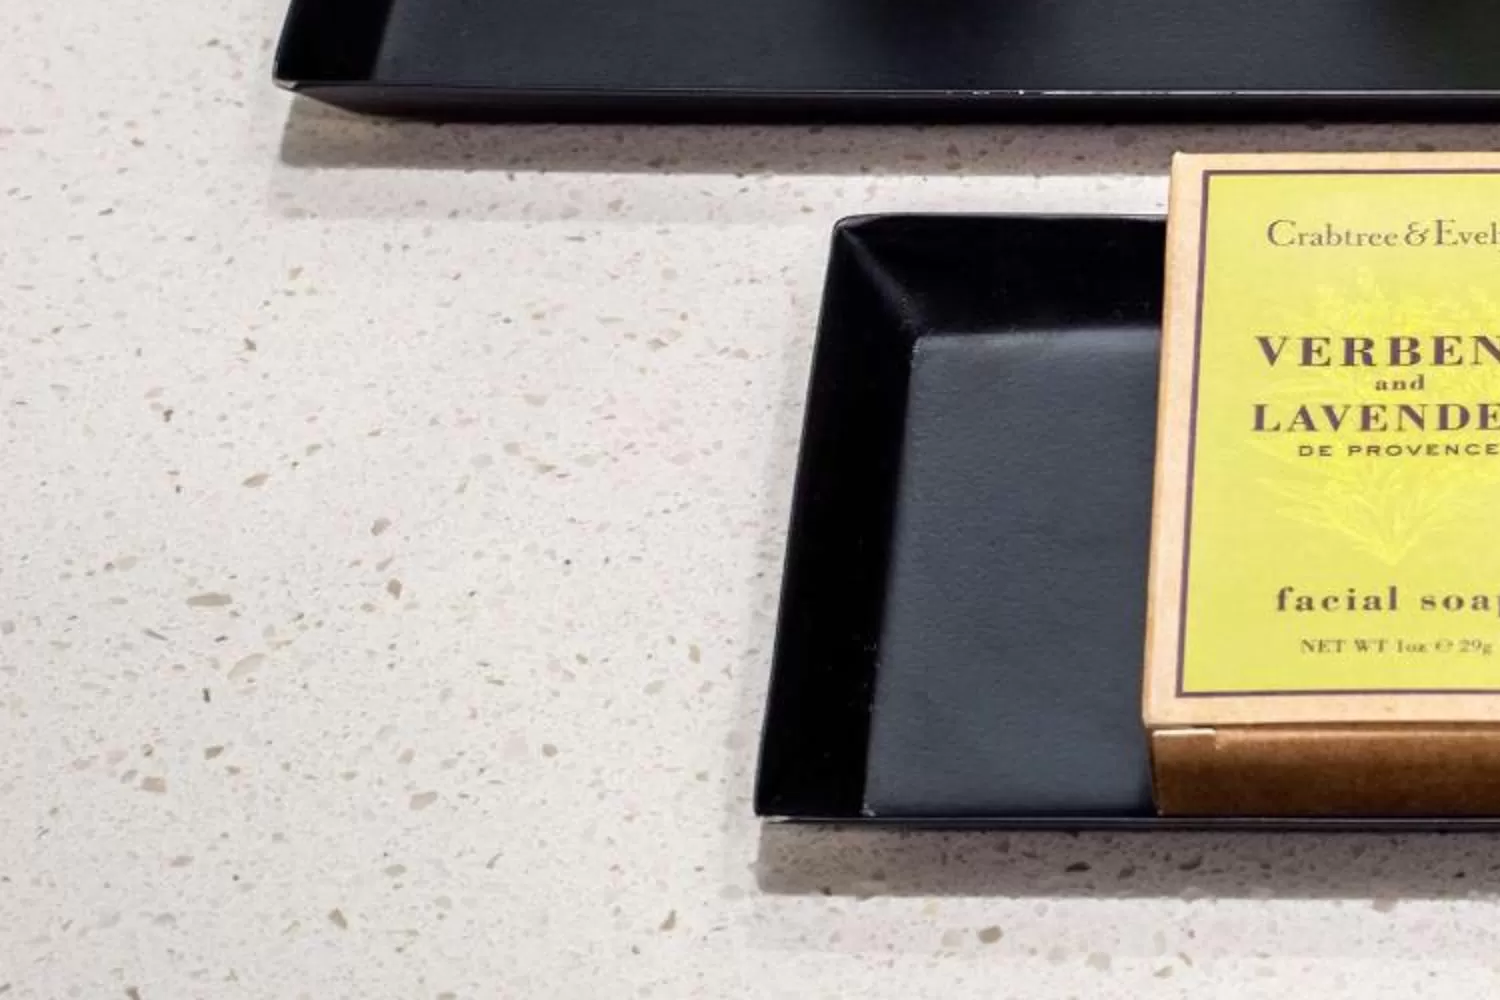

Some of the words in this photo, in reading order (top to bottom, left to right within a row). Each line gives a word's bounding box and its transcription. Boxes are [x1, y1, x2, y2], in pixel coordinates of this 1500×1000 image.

[1266, 219, 1399, 248] Crabtree
[1403, 221, 1430, 247] &
[1374, 373, 1425, 391] and
[1298, 444, 1333, 457] DE
[1347, 443, 1500, 457] PROVENCE
[1276, 585, 1399, 612] facial
[1301, 638, 1346, 653] NET
[1353, 638, 1388, 653] WT
